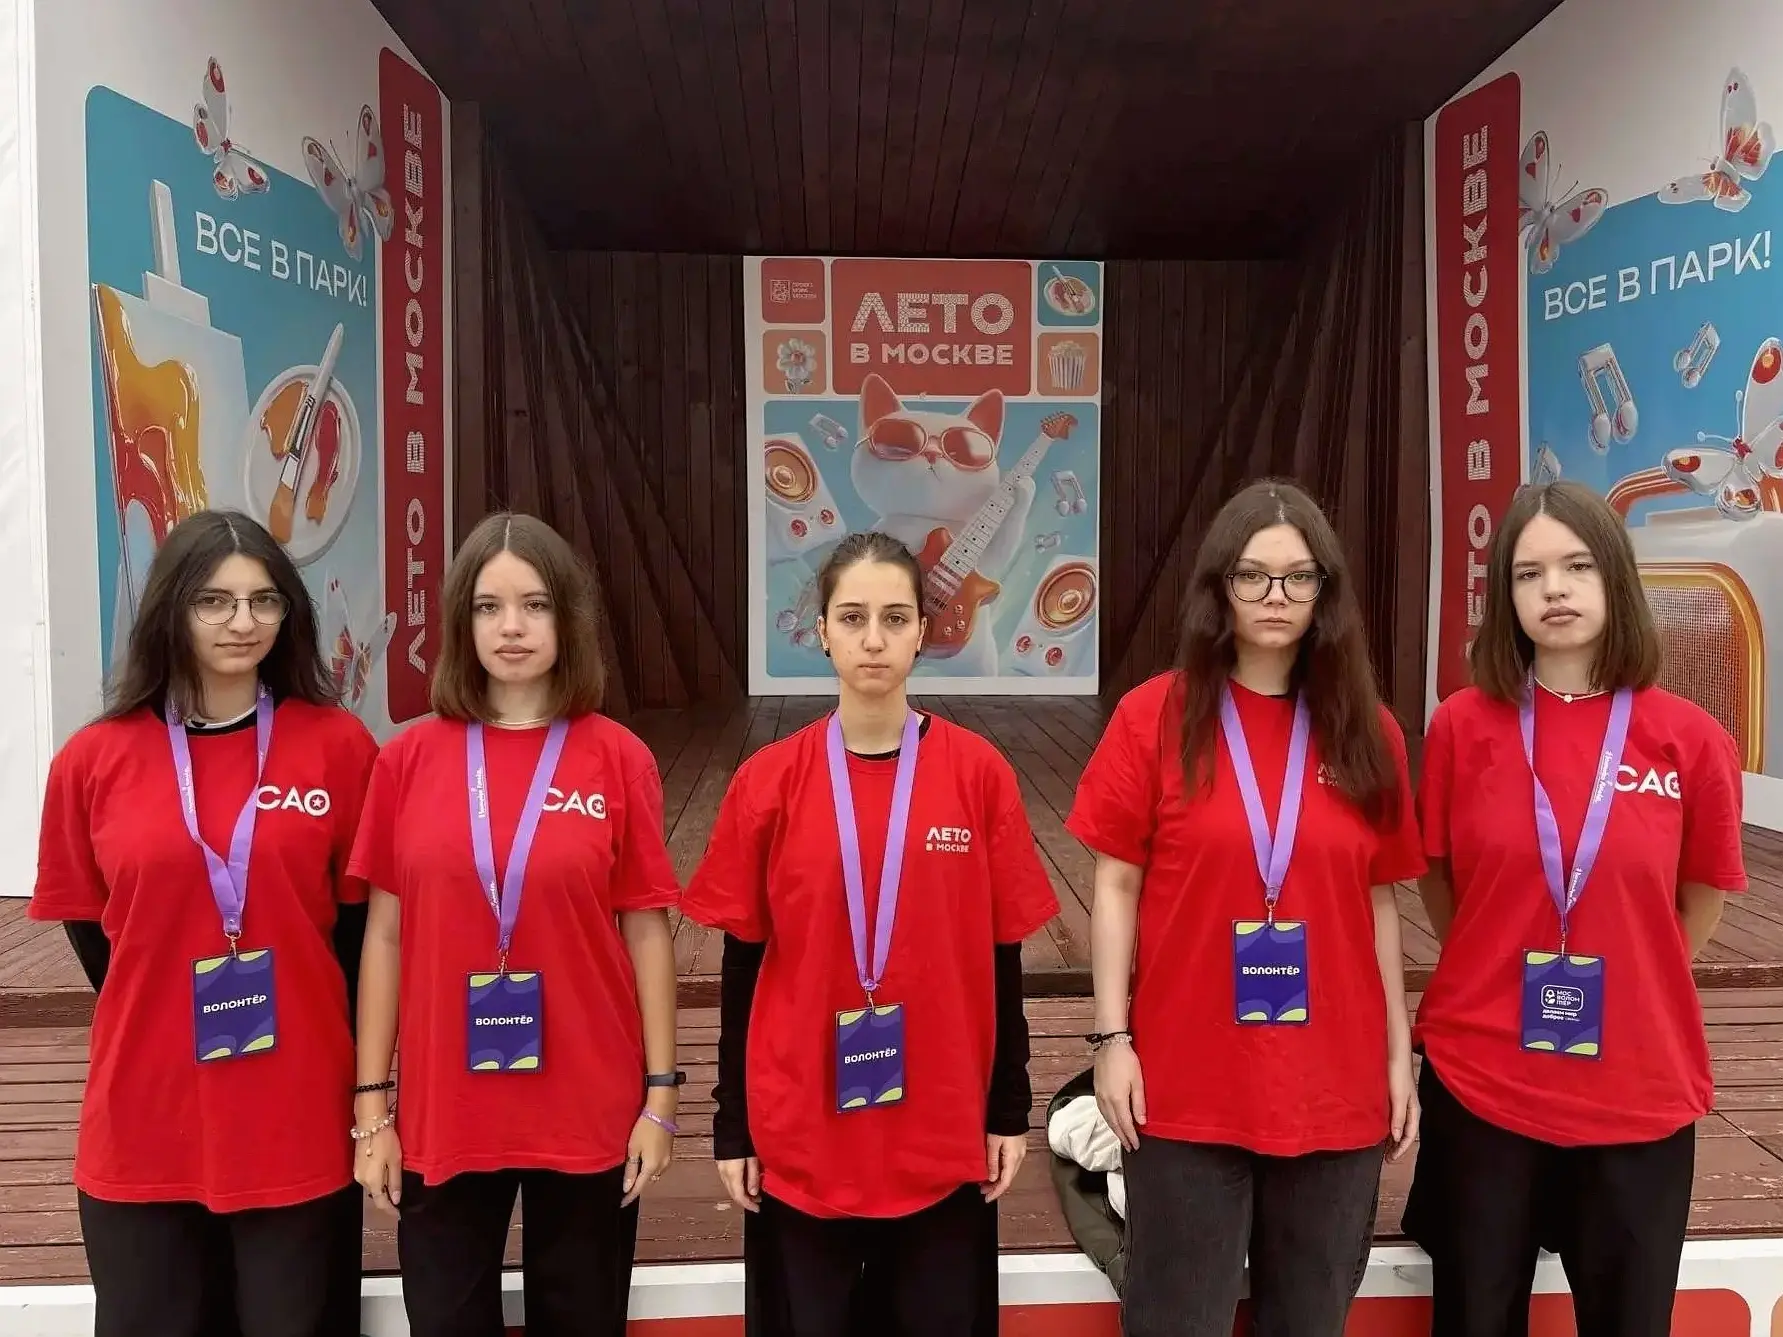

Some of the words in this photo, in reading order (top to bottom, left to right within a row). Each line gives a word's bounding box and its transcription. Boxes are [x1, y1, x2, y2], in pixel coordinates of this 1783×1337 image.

[196, 211, 261, 271] ВСЕ
[271, 239, 289, 280] В
[296, 250, 367, 307] ПАРК!
[404, 104, 424, 405] МОСКВЕ
[1463, 125, 1489, 415] МОСКВЕ
[1544, 274, 1607, 320] ВСЕ
[1618, 266, 1641, 303] В
[1651, 230, 1771, 295] ПАРК!
[851, 292, 1015, 335] ЛЕТО
[850, 343, 870, 364] В
[881, 343, 1013, 365] МОСКВЕ
[406, 431, 424, 474] В
[1467, 439, 1491, 481] В
[407, 498, 426, 674] ЛЕТО
[1465, 504, 1492, 659] ЕТО
[256, 785, 331, 817] САО
[926, 826, 972, 843] ЛЕТО
[936, 843, 970, 853] МОСКВЕ
[1242, 966, 1300, 975] ВОЛОНТЁР
[203, 994, 267, 1013] ВОЛОНТЁР
[475, 1015, 533, 1026] ВОЛОНТЁР
[844, 1048, 897, 1064] ВОЛОНТЁР
